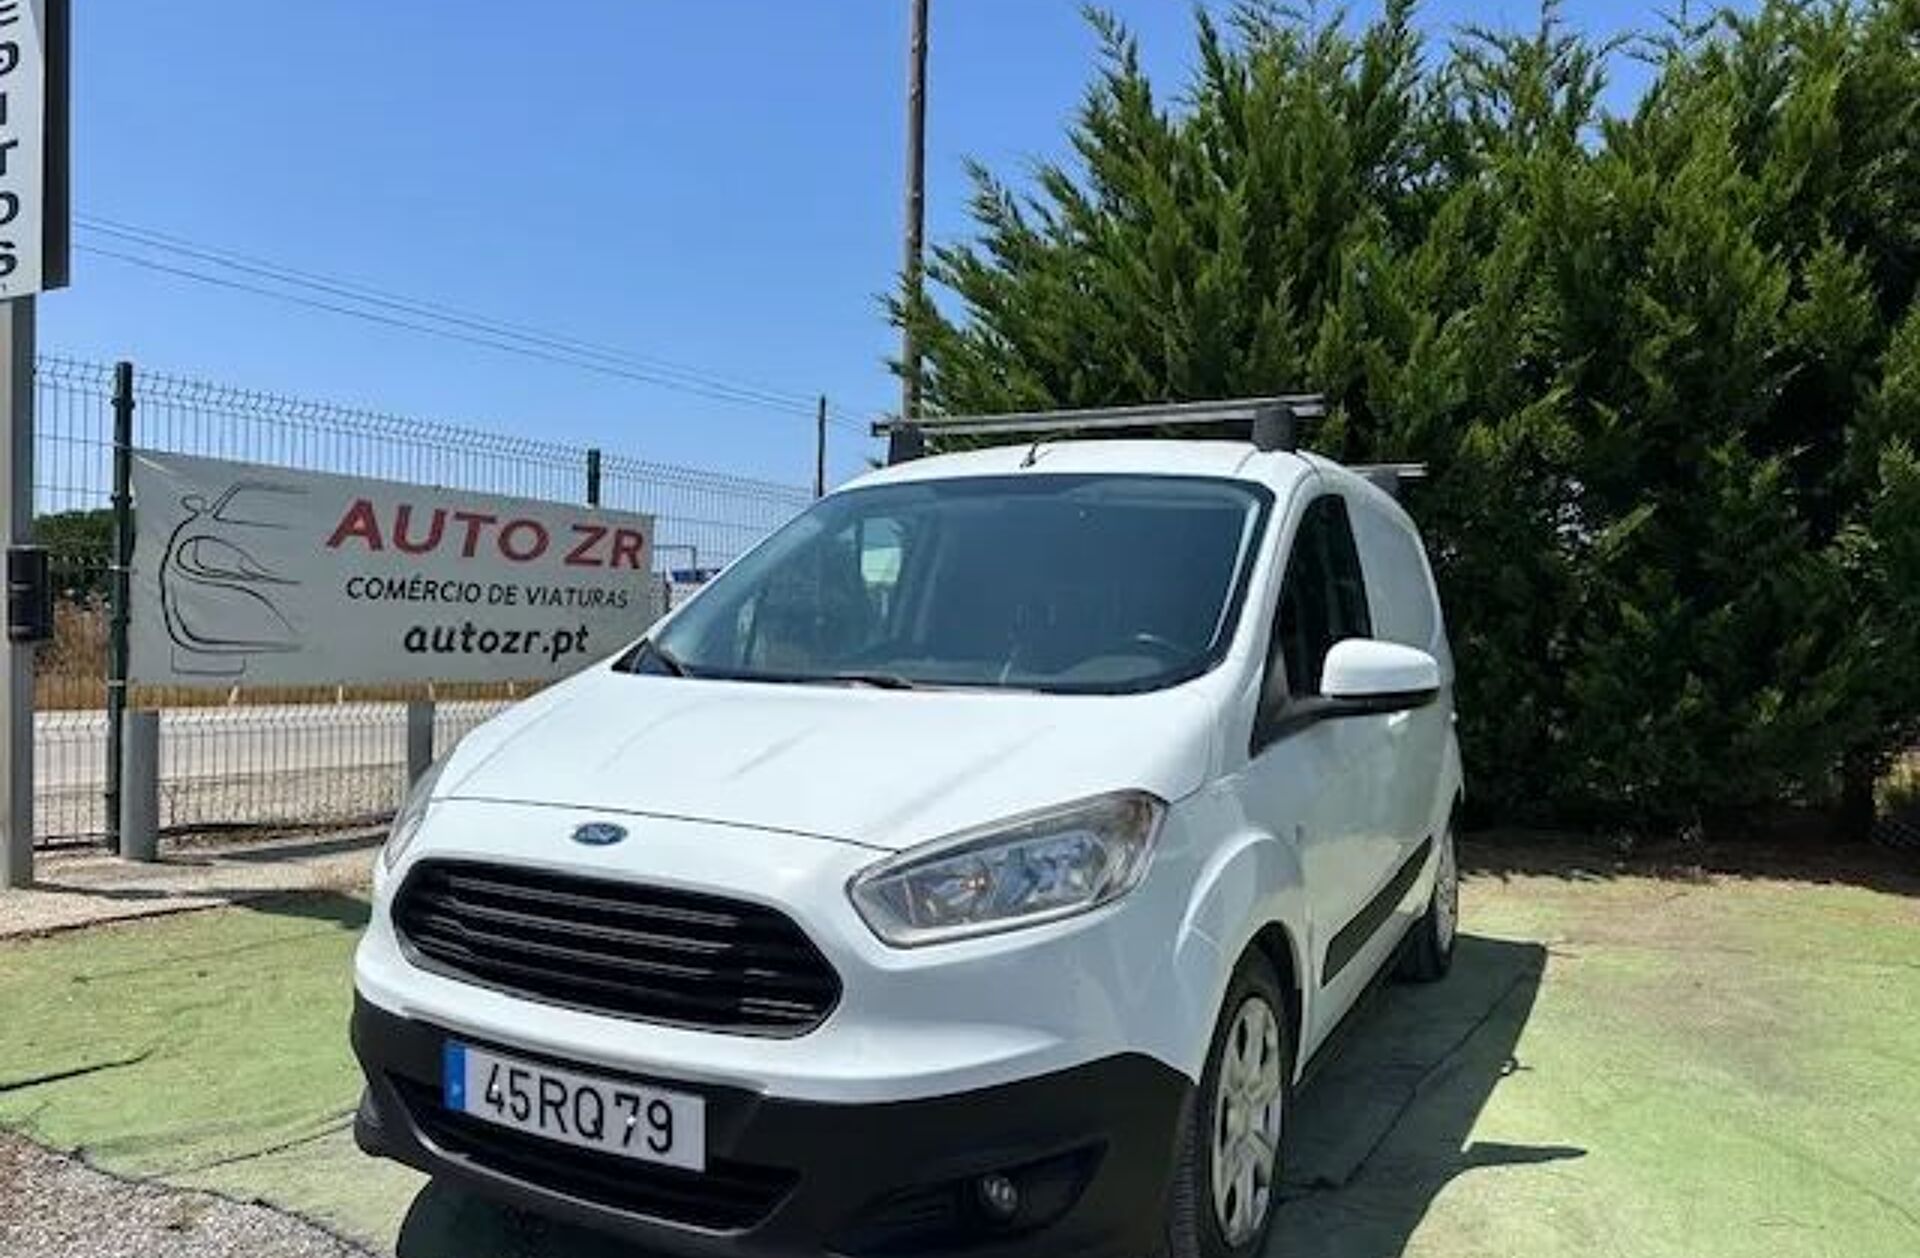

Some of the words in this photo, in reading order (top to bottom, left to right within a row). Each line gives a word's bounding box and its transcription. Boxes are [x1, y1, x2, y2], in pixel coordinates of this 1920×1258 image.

[326, 499, 550, 561] AUTO
[564, 523, 645, 569] ZR
[346, 572, 482, 605] COMÉRCIO
[488, 582, 520, 606] DE
[525, 584, 630, 610] VIATURAS
[403, 621, 590, 663] autozr.pt
